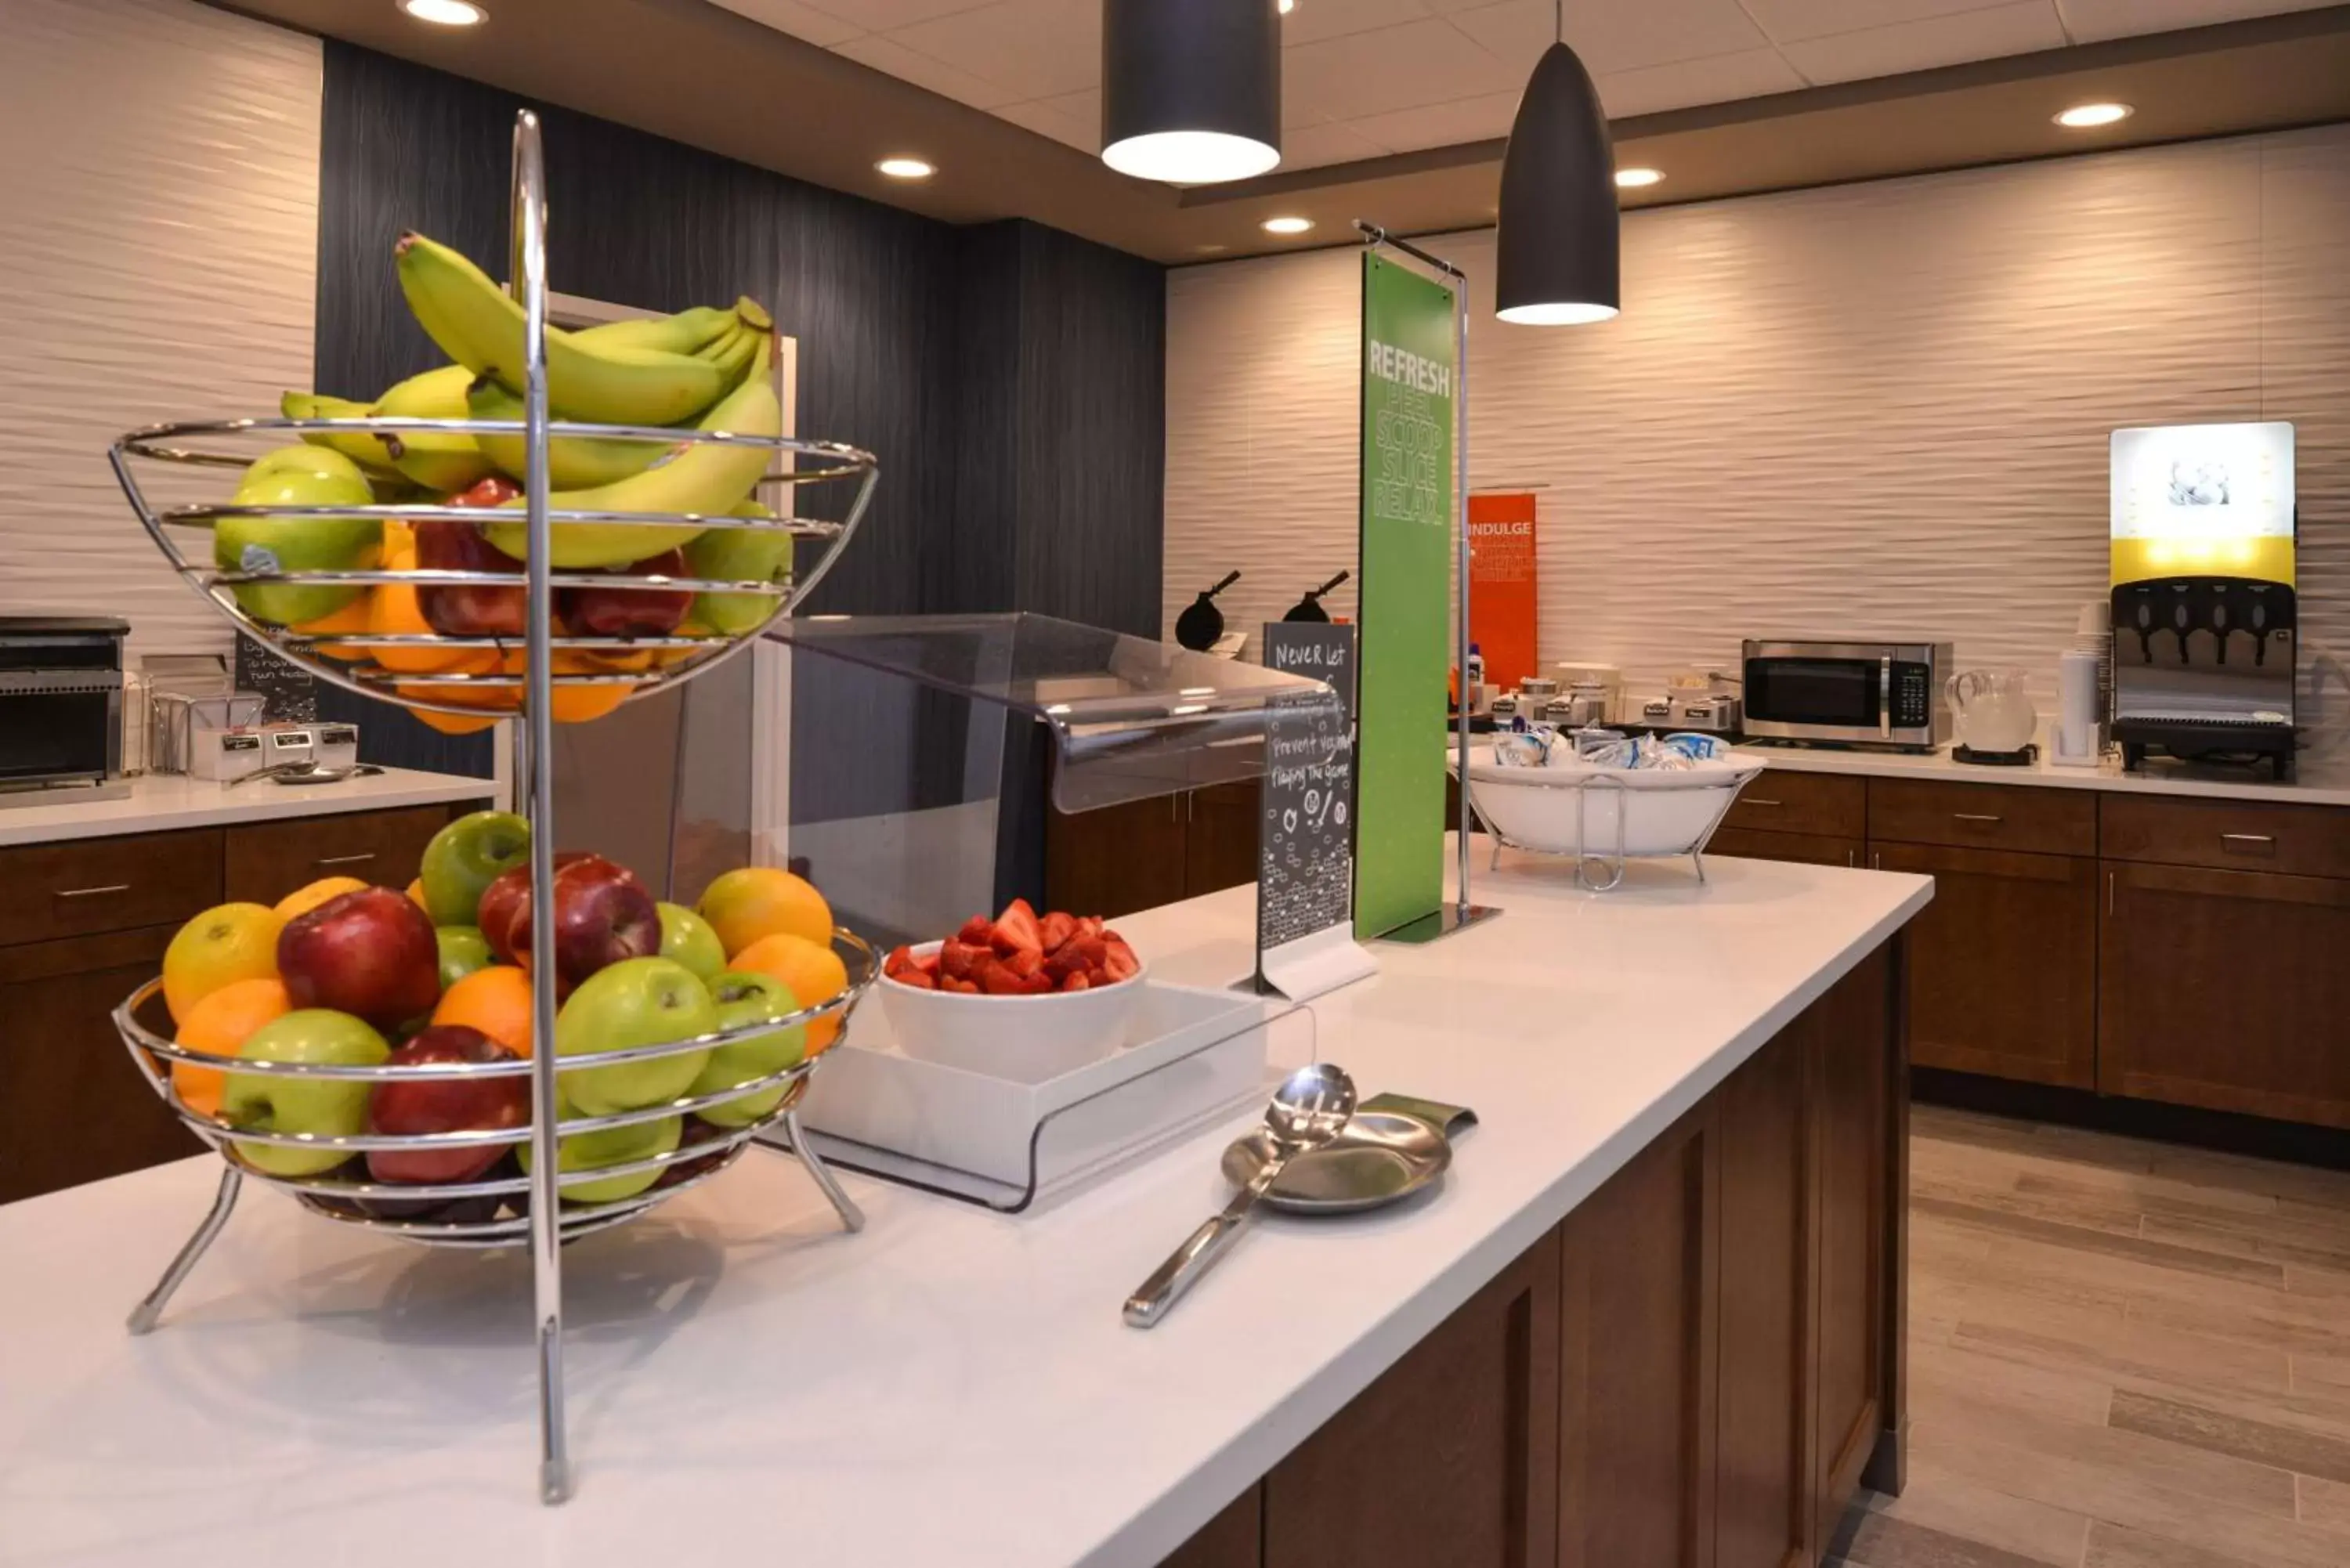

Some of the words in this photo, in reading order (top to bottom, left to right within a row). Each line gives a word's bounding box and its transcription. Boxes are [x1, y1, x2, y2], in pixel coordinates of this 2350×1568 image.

[1370, 338, 1449, 398] REFRESH
[1376, 409, 1444, 457] SCOOP
[1382, 447, 1437, 492] SLICE
[1468, 522, 1531, 537] INDULGE
